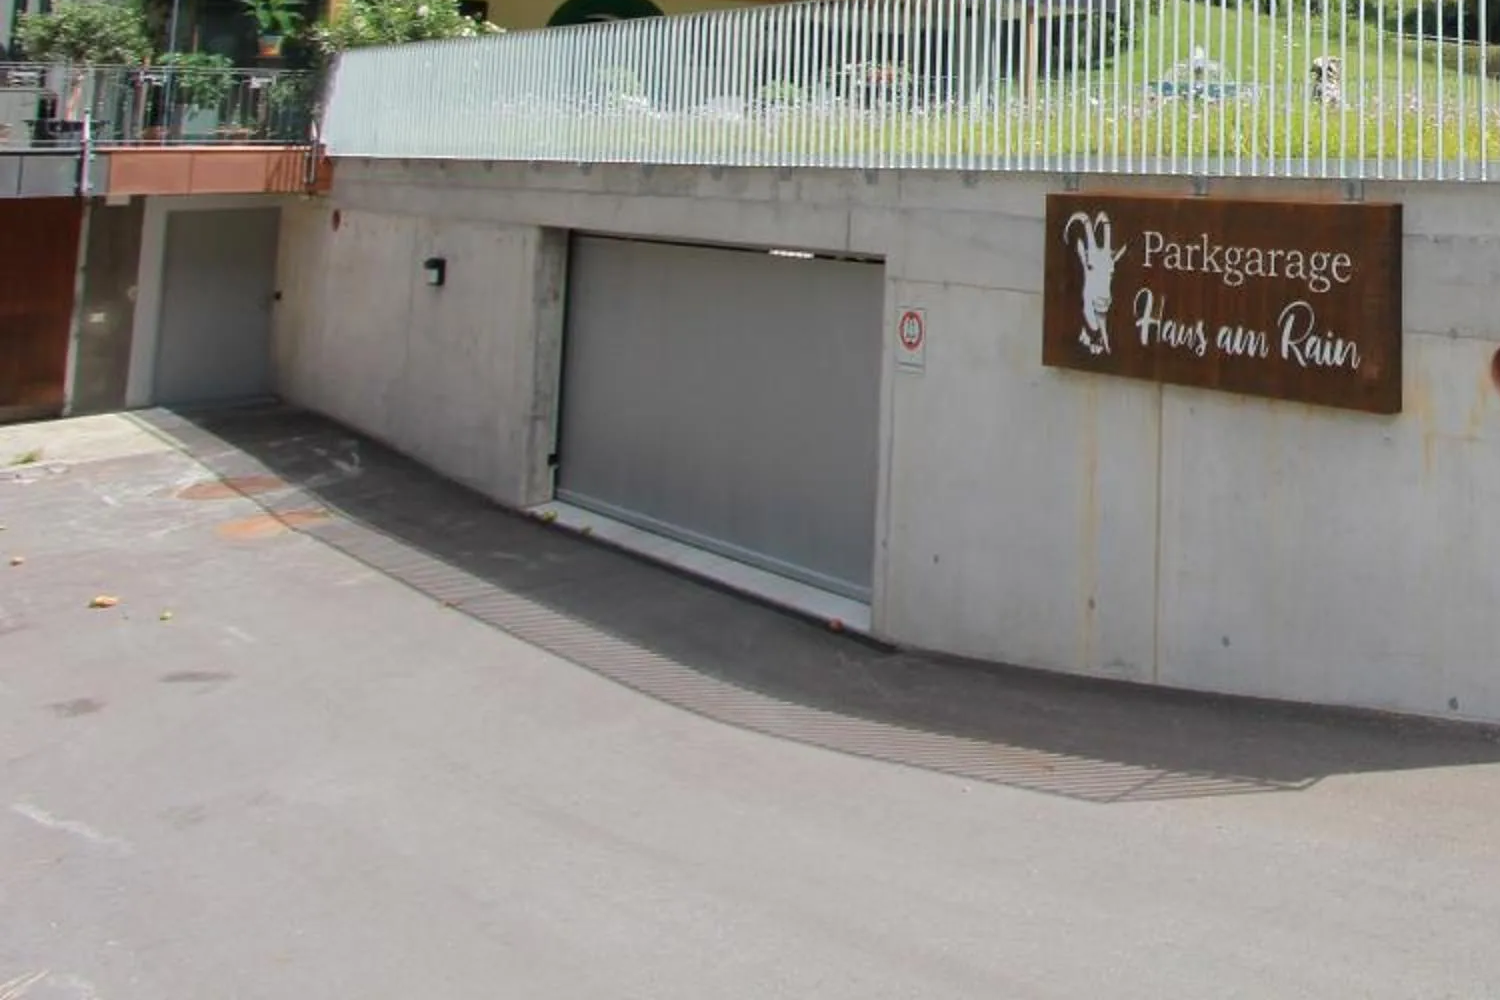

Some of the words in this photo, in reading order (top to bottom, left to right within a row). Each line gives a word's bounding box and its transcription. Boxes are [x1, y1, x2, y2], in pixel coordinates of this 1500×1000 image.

[1143, 230, 1352, 293] Parkgarage
[1133, 287, 1208, 358] Haus
[1216, 324, 1269, 360] am
[1277, 300, 1361, 370] Rain
